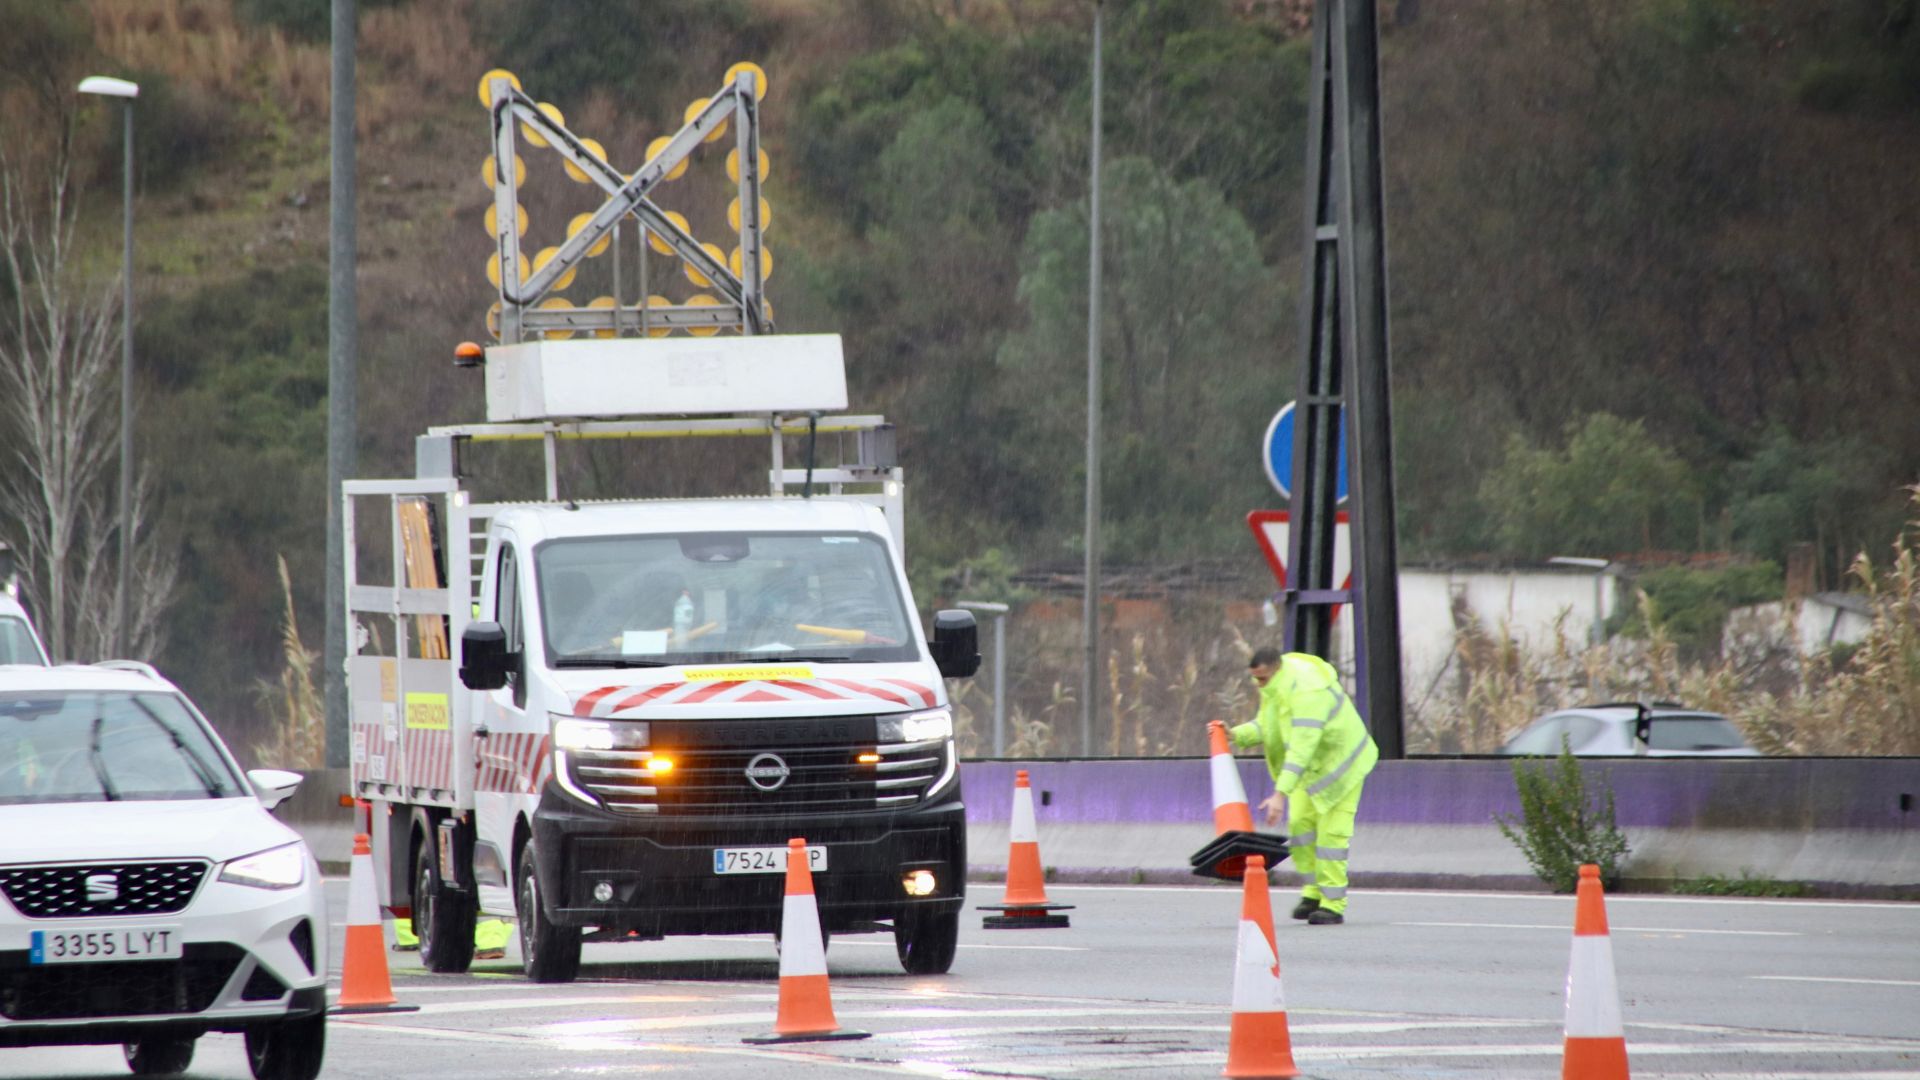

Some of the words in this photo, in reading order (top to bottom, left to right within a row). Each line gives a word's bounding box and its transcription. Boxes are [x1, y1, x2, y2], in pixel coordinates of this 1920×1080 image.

[746, 768, 790, 777] NISSAN
[727, 851, 776, 870] 7524
[53, 933, 115, 957] 3355
[126, 931, 171, 954] LYT
